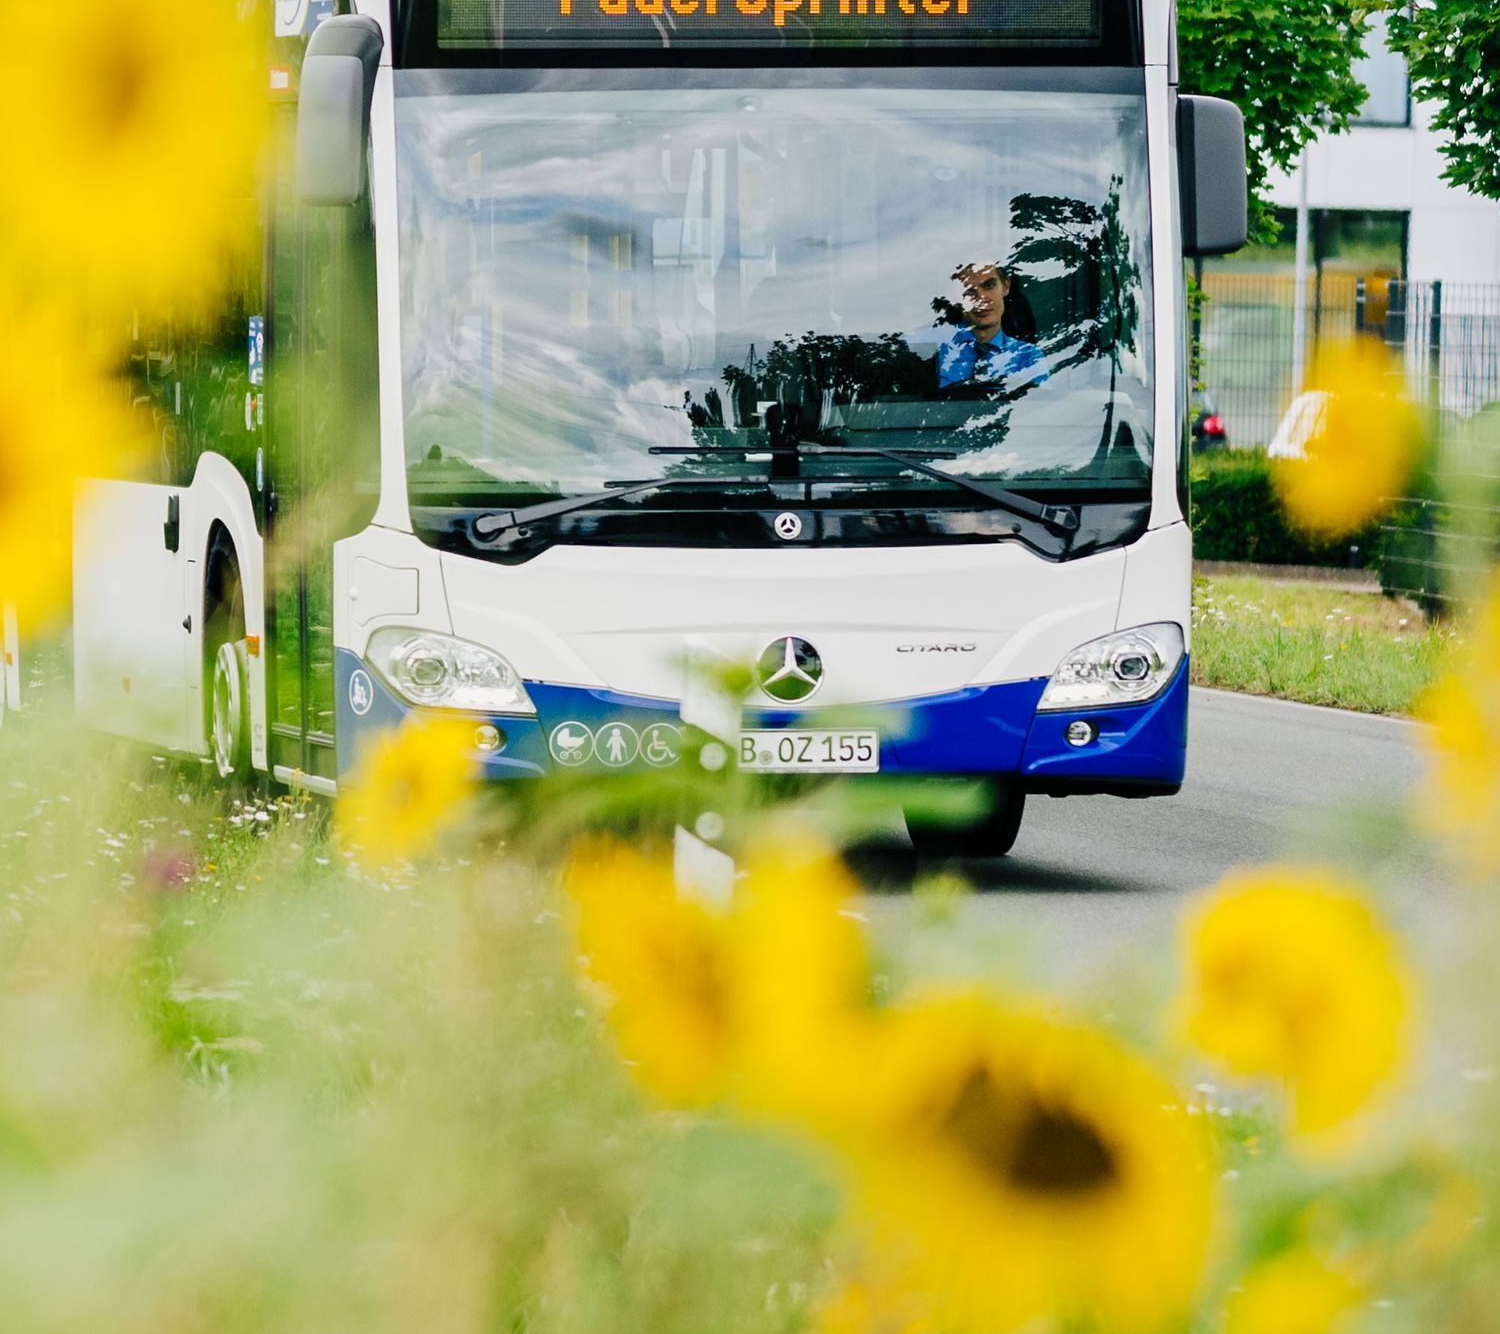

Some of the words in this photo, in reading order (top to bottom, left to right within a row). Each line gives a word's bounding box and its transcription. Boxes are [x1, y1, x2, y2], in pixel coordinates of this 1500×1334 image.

[896, 643, 977, 653] CITARO
[778, 736, 814, 763] OZ
[821, 735, 873, 762] 155
